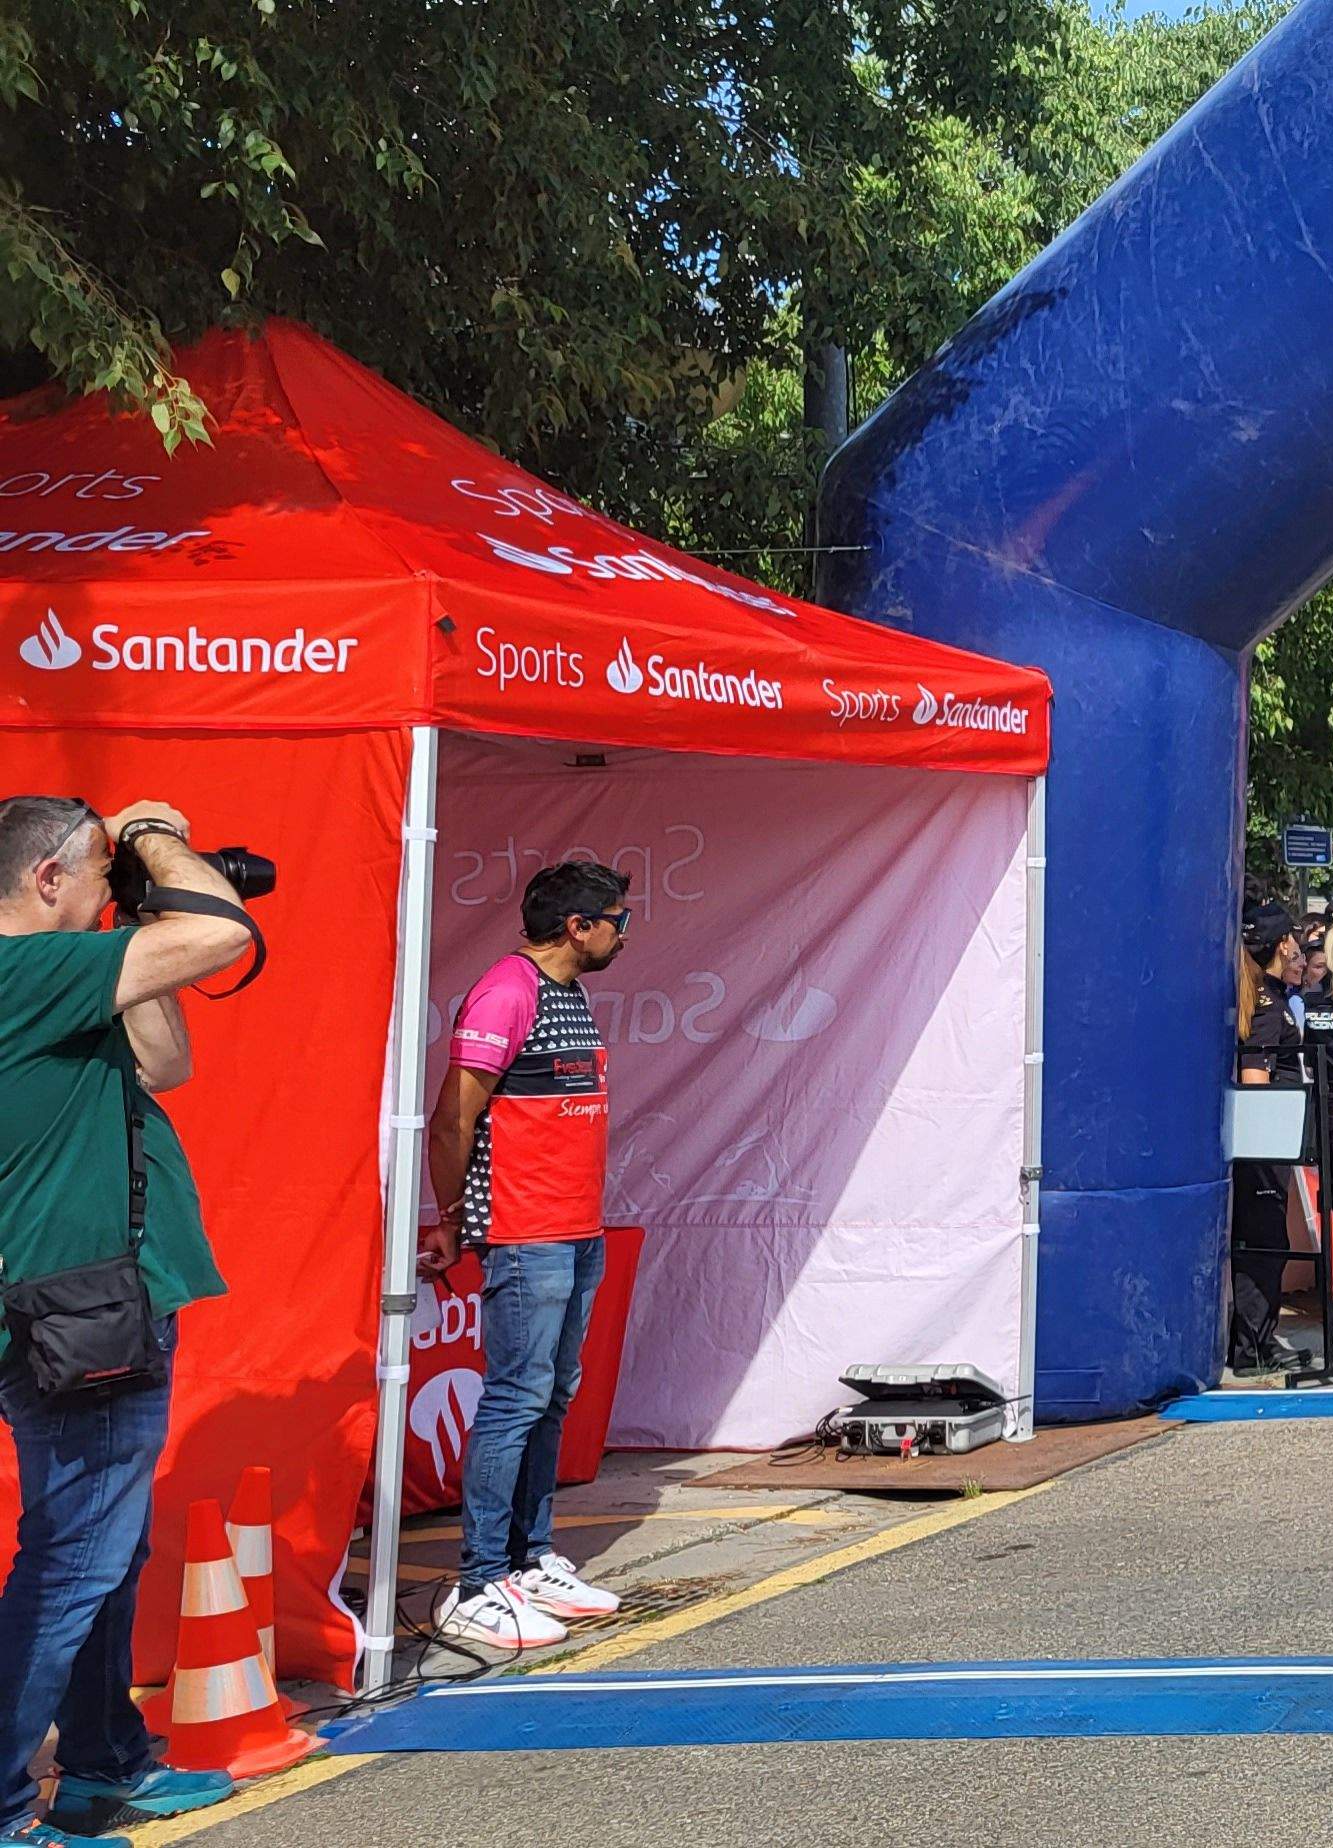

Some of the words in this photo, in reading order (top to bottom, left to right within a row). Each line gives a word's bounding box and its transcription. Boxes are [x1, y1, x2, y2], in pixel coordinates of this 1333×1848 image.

[0, 469, 161, 499] orts
[92, 624, 358, 673] Santander
[476, 627, 584, 691] Sports
[648, 655, 783, 709] Santander
[822, 679, 901, 727] Sports
[936, 693, 1029, 734] Santander
